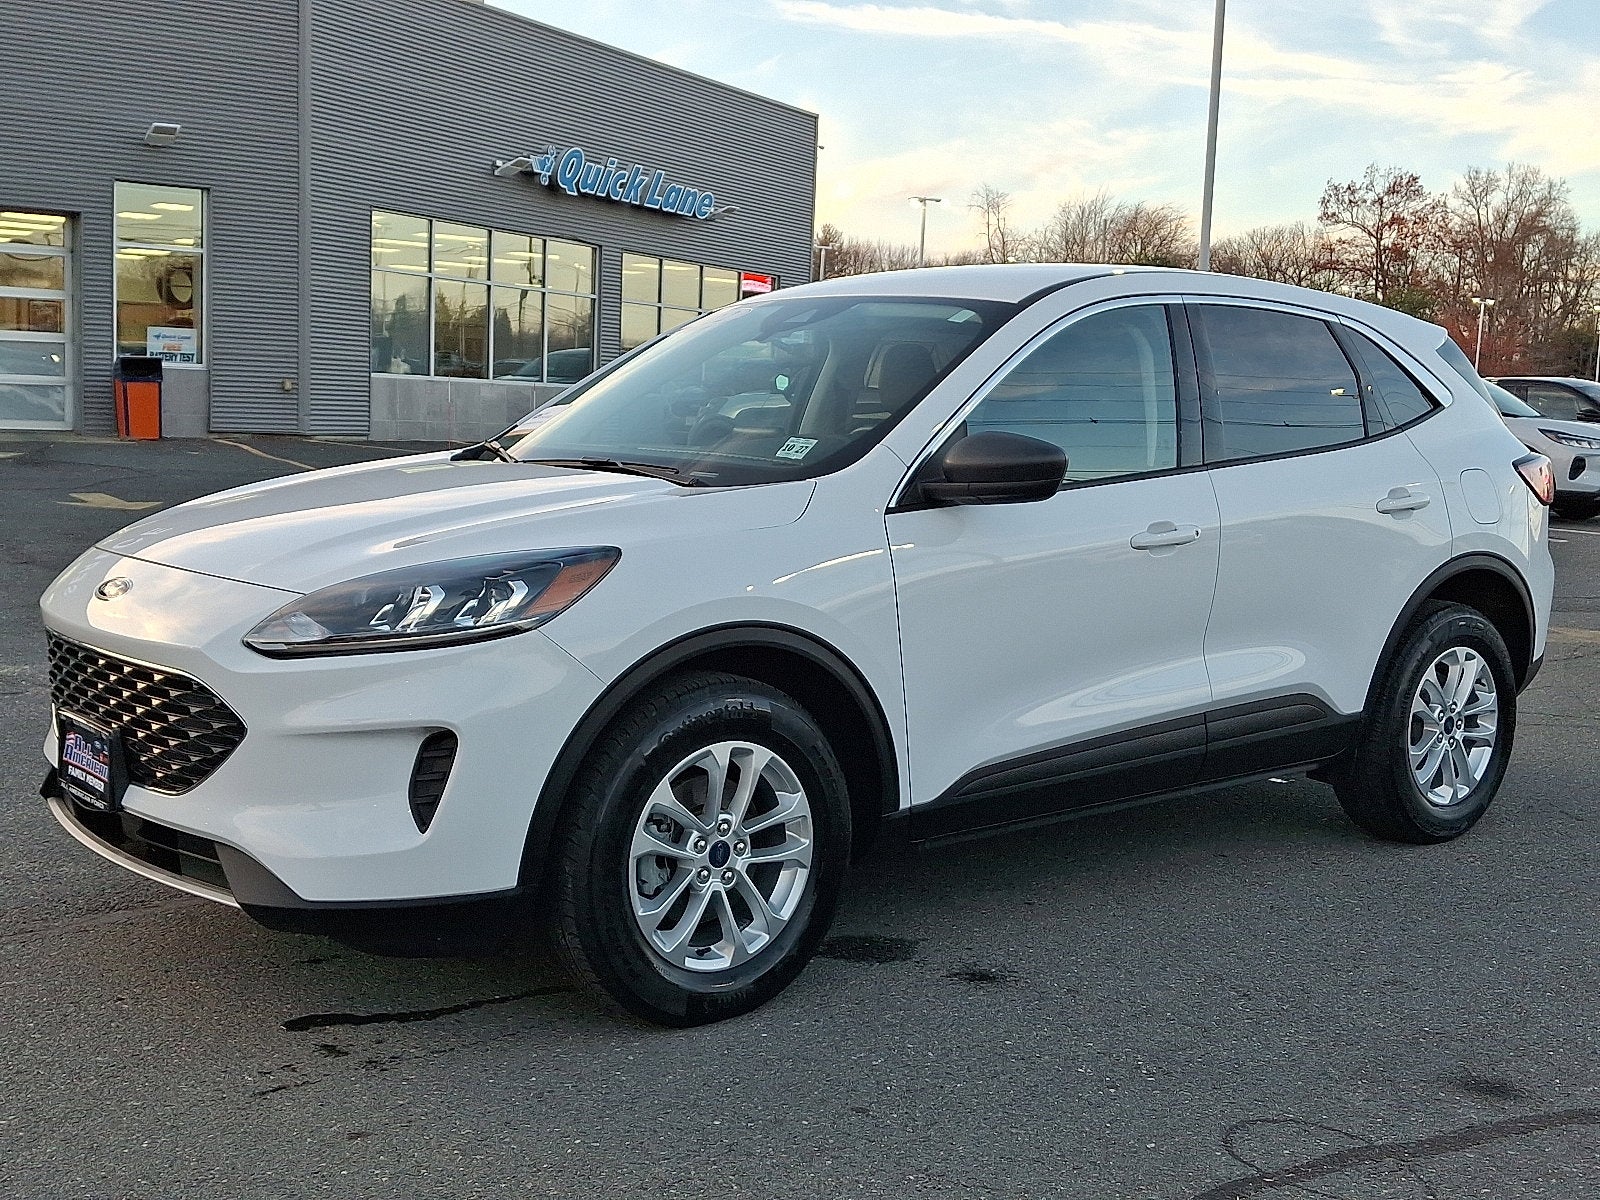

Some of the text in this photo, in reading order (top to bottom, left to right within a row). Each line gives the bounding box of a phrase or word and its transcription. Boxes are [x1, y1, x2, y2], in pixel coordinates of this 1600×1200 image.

[557, 147, 715, 219] Quick Lane
[179, 352, 195, 362] TEST
[782, 444, 796, 452] 10
[73, 733, 93, 759] ALL
[63, 742, 109, 780] AMERICAN
